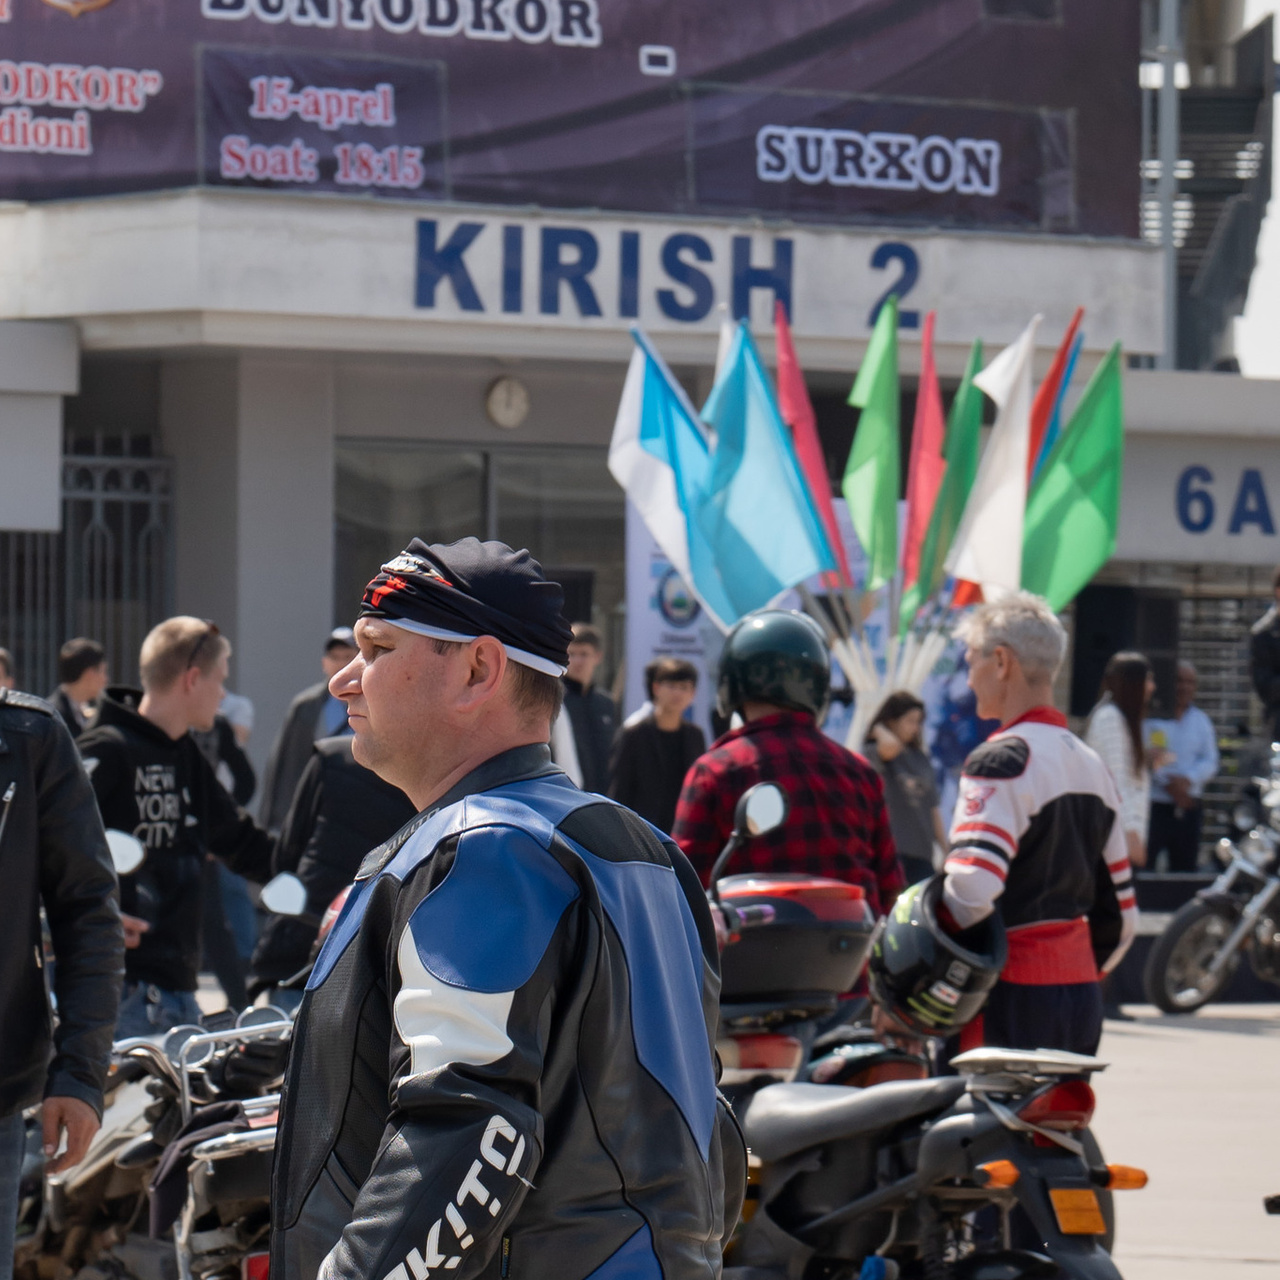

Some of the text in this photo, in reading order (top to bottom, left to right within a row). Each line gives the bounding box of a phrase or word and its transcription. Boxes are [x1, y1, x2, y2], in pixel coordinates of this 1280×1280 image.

[250, 76, 395, 129] 15-aprel
[222, 136, 424, 188] Soat: 18:15
[757, 125, 1000, 195] SURXON
[414, 218, 922, 330] KIRISH 2
[1175, 463, 1277, 536] 6A
